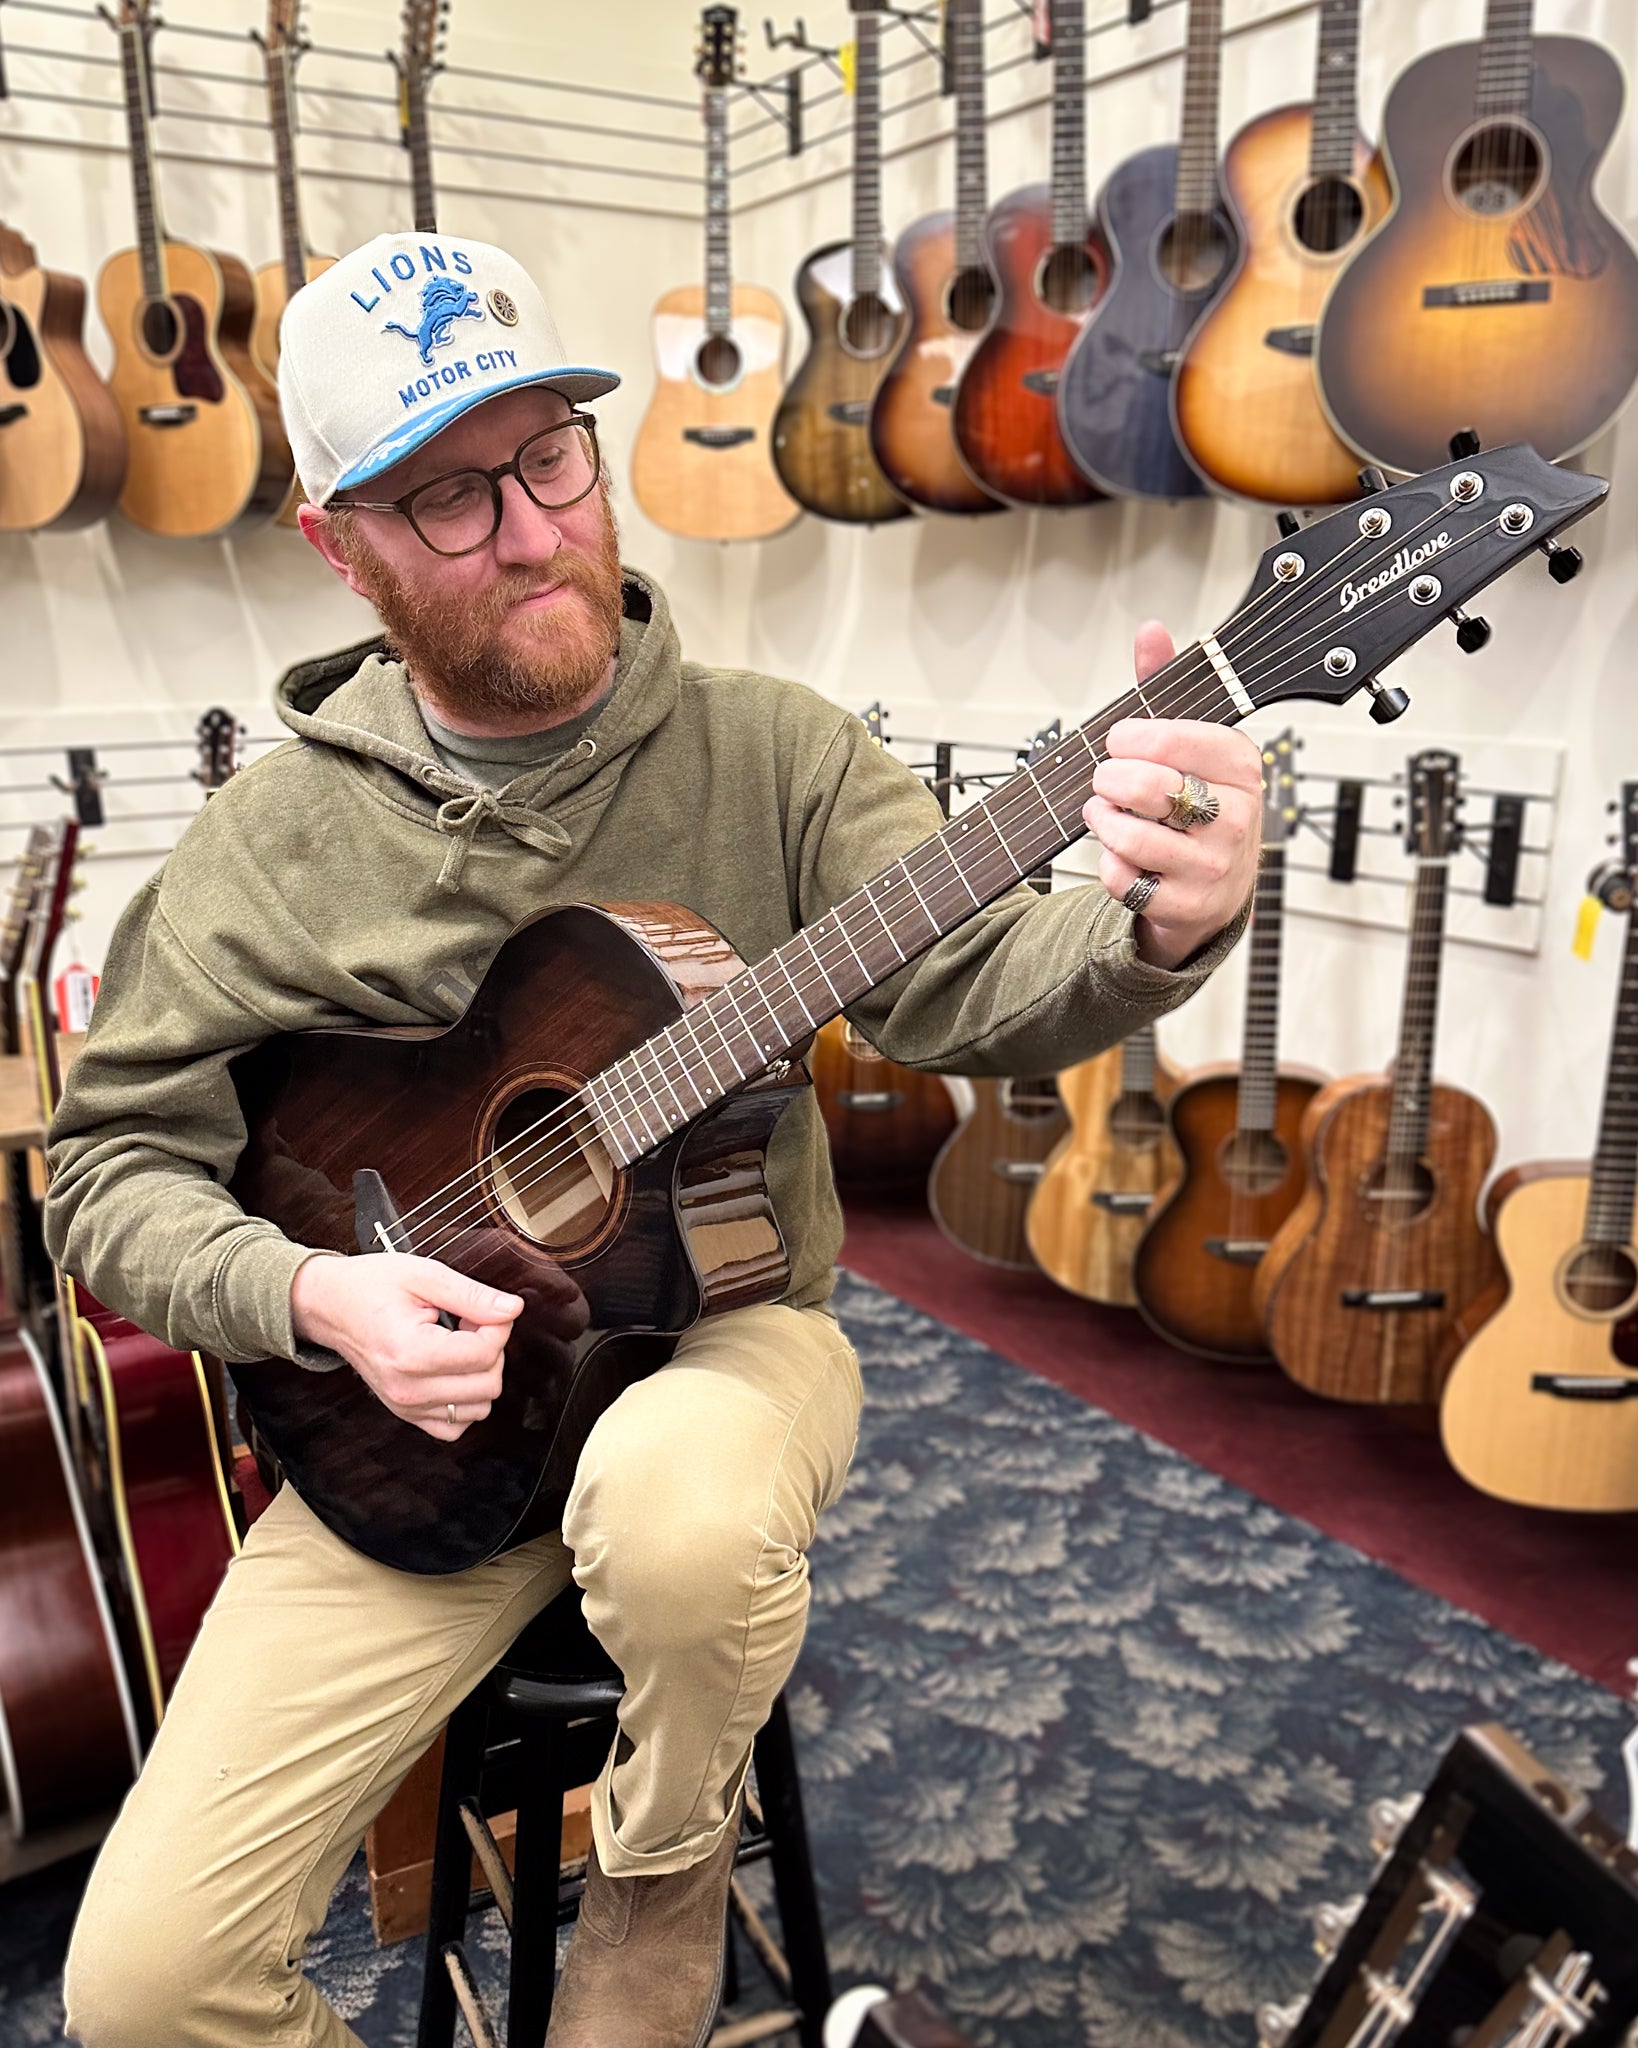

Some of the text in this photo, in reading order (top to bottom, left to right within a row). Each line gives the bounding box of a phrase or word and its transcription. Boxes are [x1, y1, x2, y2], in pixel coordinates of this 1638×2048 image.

[350, 245, 473, 313] LIONS
[398, 349, 518, 408] MOTOR CITY
[1340, 531, 1453, 613] Breedlove
